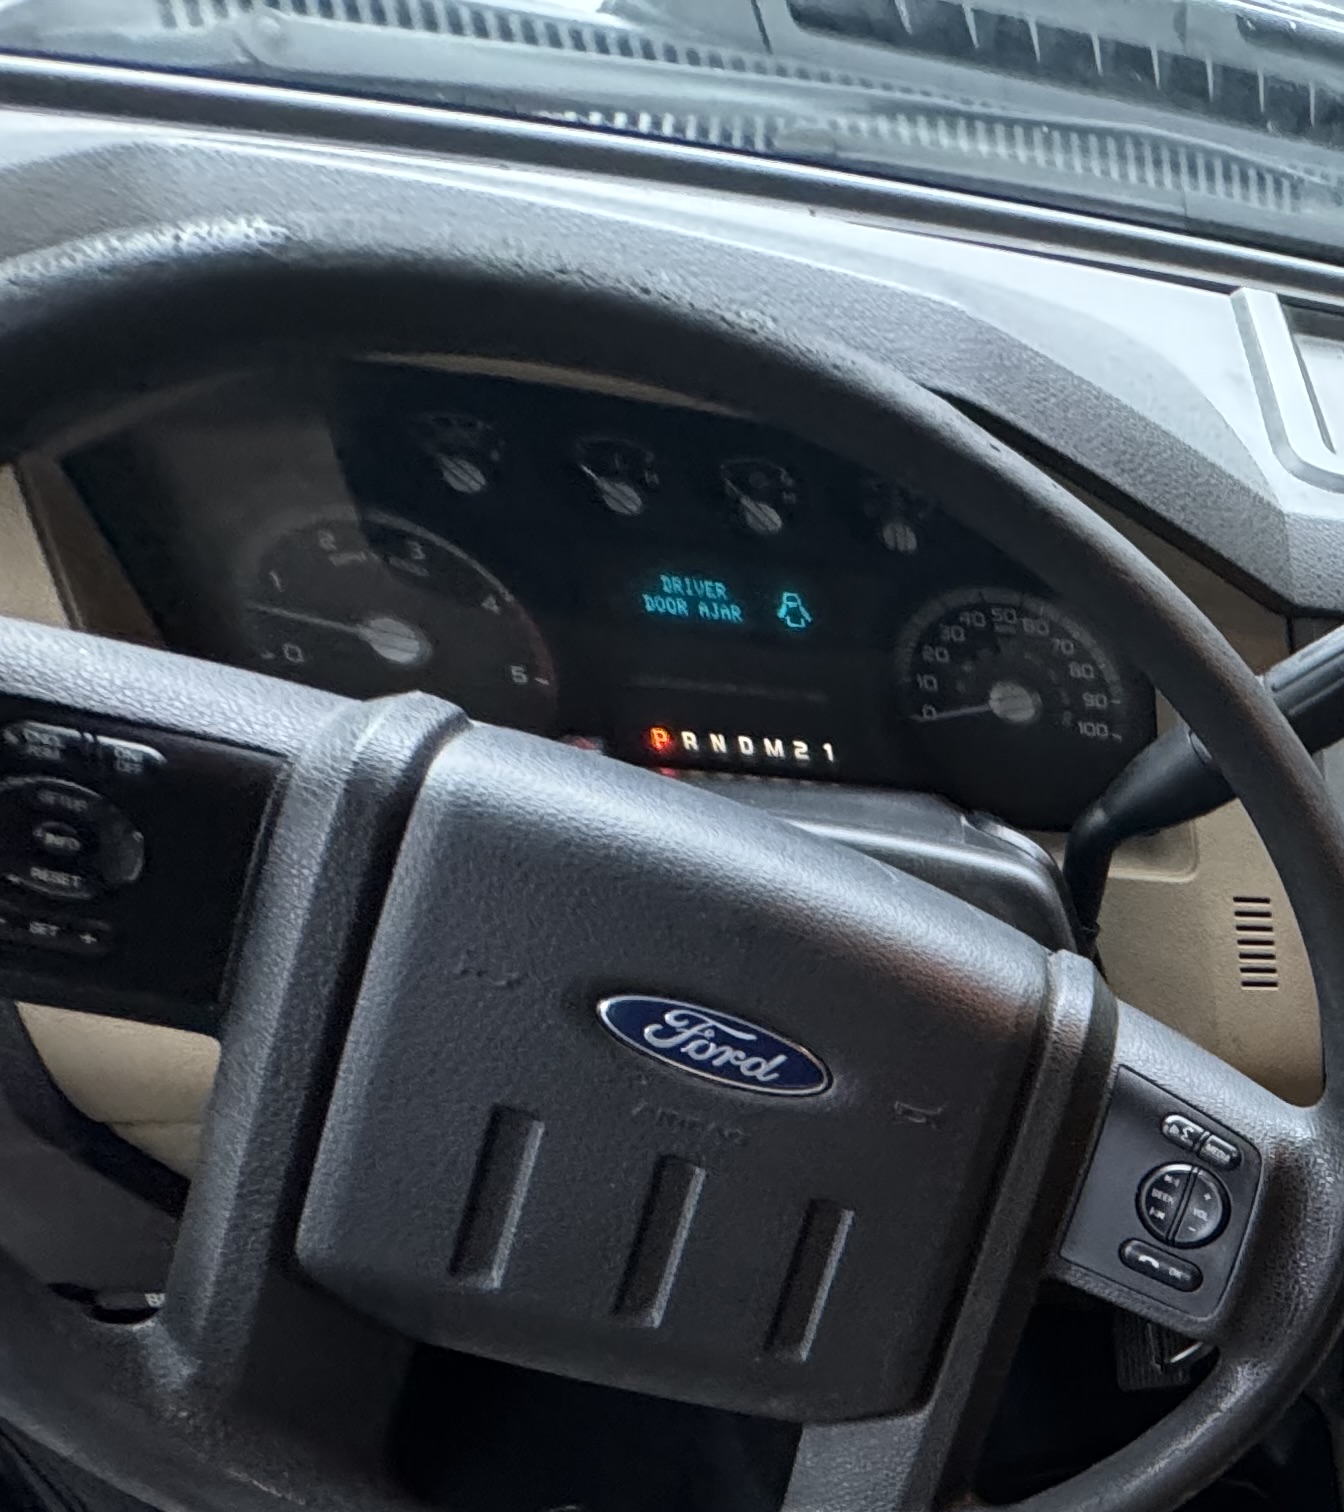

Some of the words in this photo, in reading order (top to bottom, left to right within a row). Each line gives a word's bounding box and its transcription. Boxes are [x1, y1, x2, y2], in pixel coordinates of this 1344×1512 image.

[660, 574, 728, 600] DRIVER
[642, 594, 689, 616] DOOR
[699, 603, 743, 623] AJAR
[991, 608, 1018, 624] 50
[960, 611, 986, 628] 40
[1022, 617, 1049, 636] 60
[939, 624, 966, 642] 30
[923, 647, 949, 663] 20
[1054, 638, 1074, 655] 70
[510, 665, 528, 684] 5
[1069, 662, 1094, 680] 80
[917, 674, 938, 691] 10
[1083, 692, 1108, 709] 90
[922, 704, 937, 720] 0
[1078, 721, 1109, 737] 100
[651, 727, 670, 749] P
[681, 731, 699, 751] R
[709, 733, 727, 754] N
[738, 735, 755, 756] D
[763, 737, 785, 759] M
[792, 740, 810, 761] 2
[822, 742, 834, 763] 1
[644, 1008, 788, 1081] Ford
[1151, 1188, 1175, 1205] SEEK
